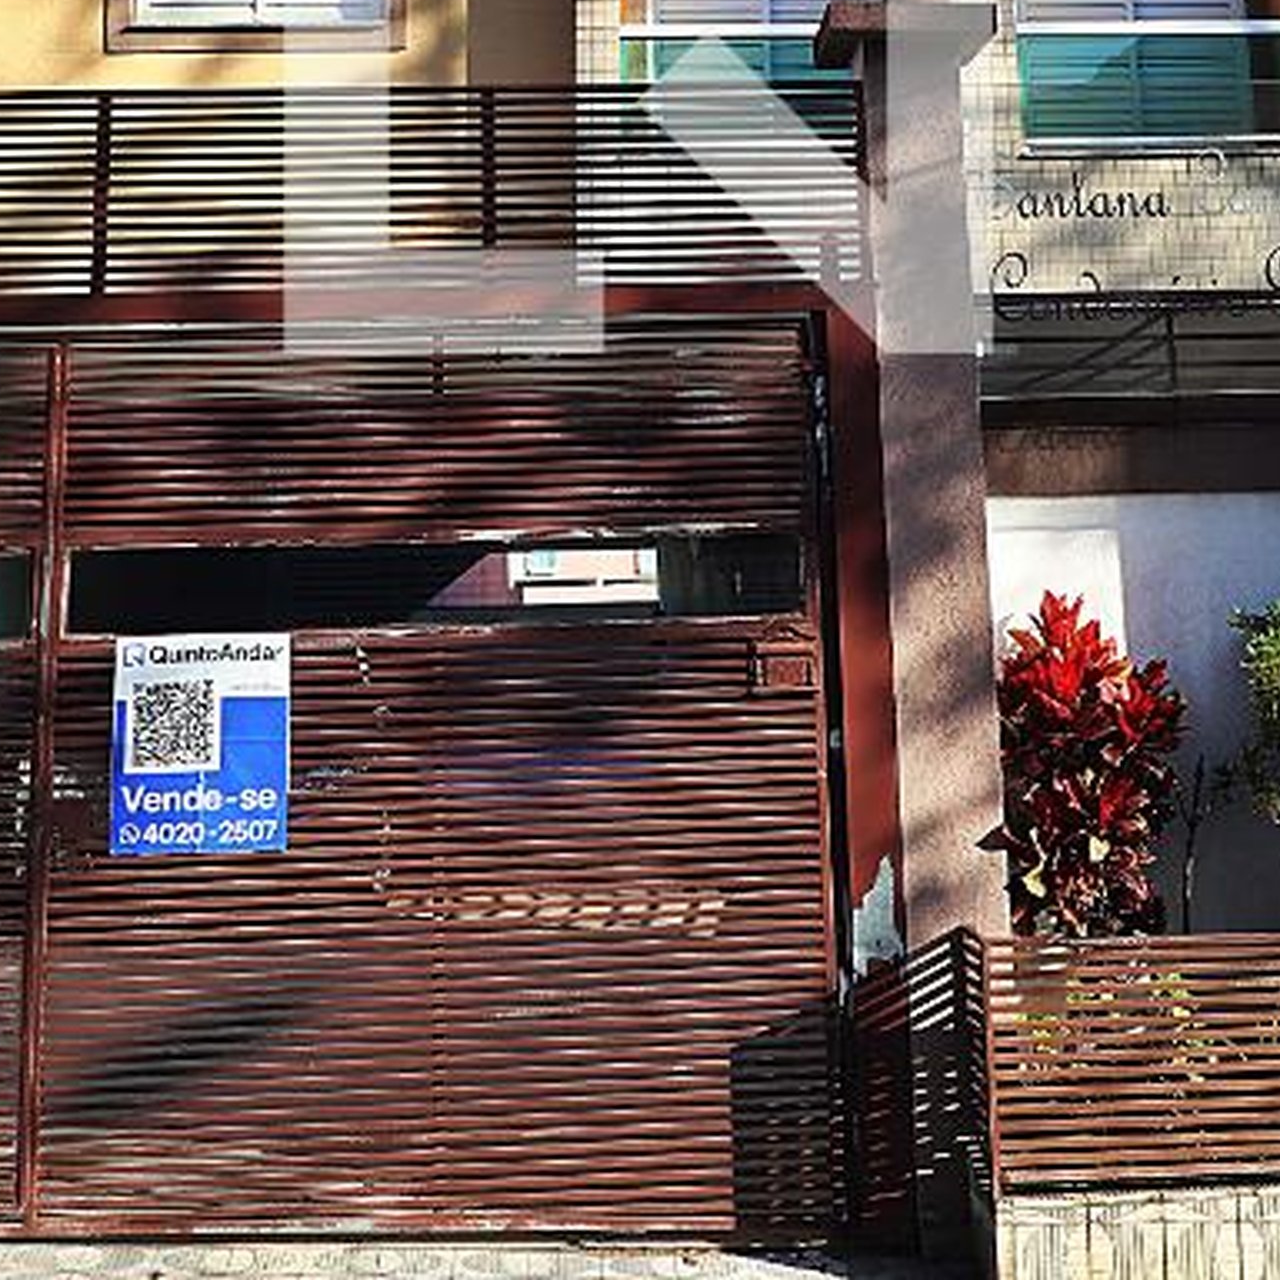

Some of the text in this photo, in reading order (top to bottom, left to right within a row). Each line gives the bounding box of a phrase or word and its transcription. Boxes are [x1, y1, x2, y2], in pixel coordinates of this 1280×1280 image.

[148, 643, 284, 666] QuintoAndar
[120, 784, 278, 814] Vende-se
[142, 819, 278, 845] 4020-2507
